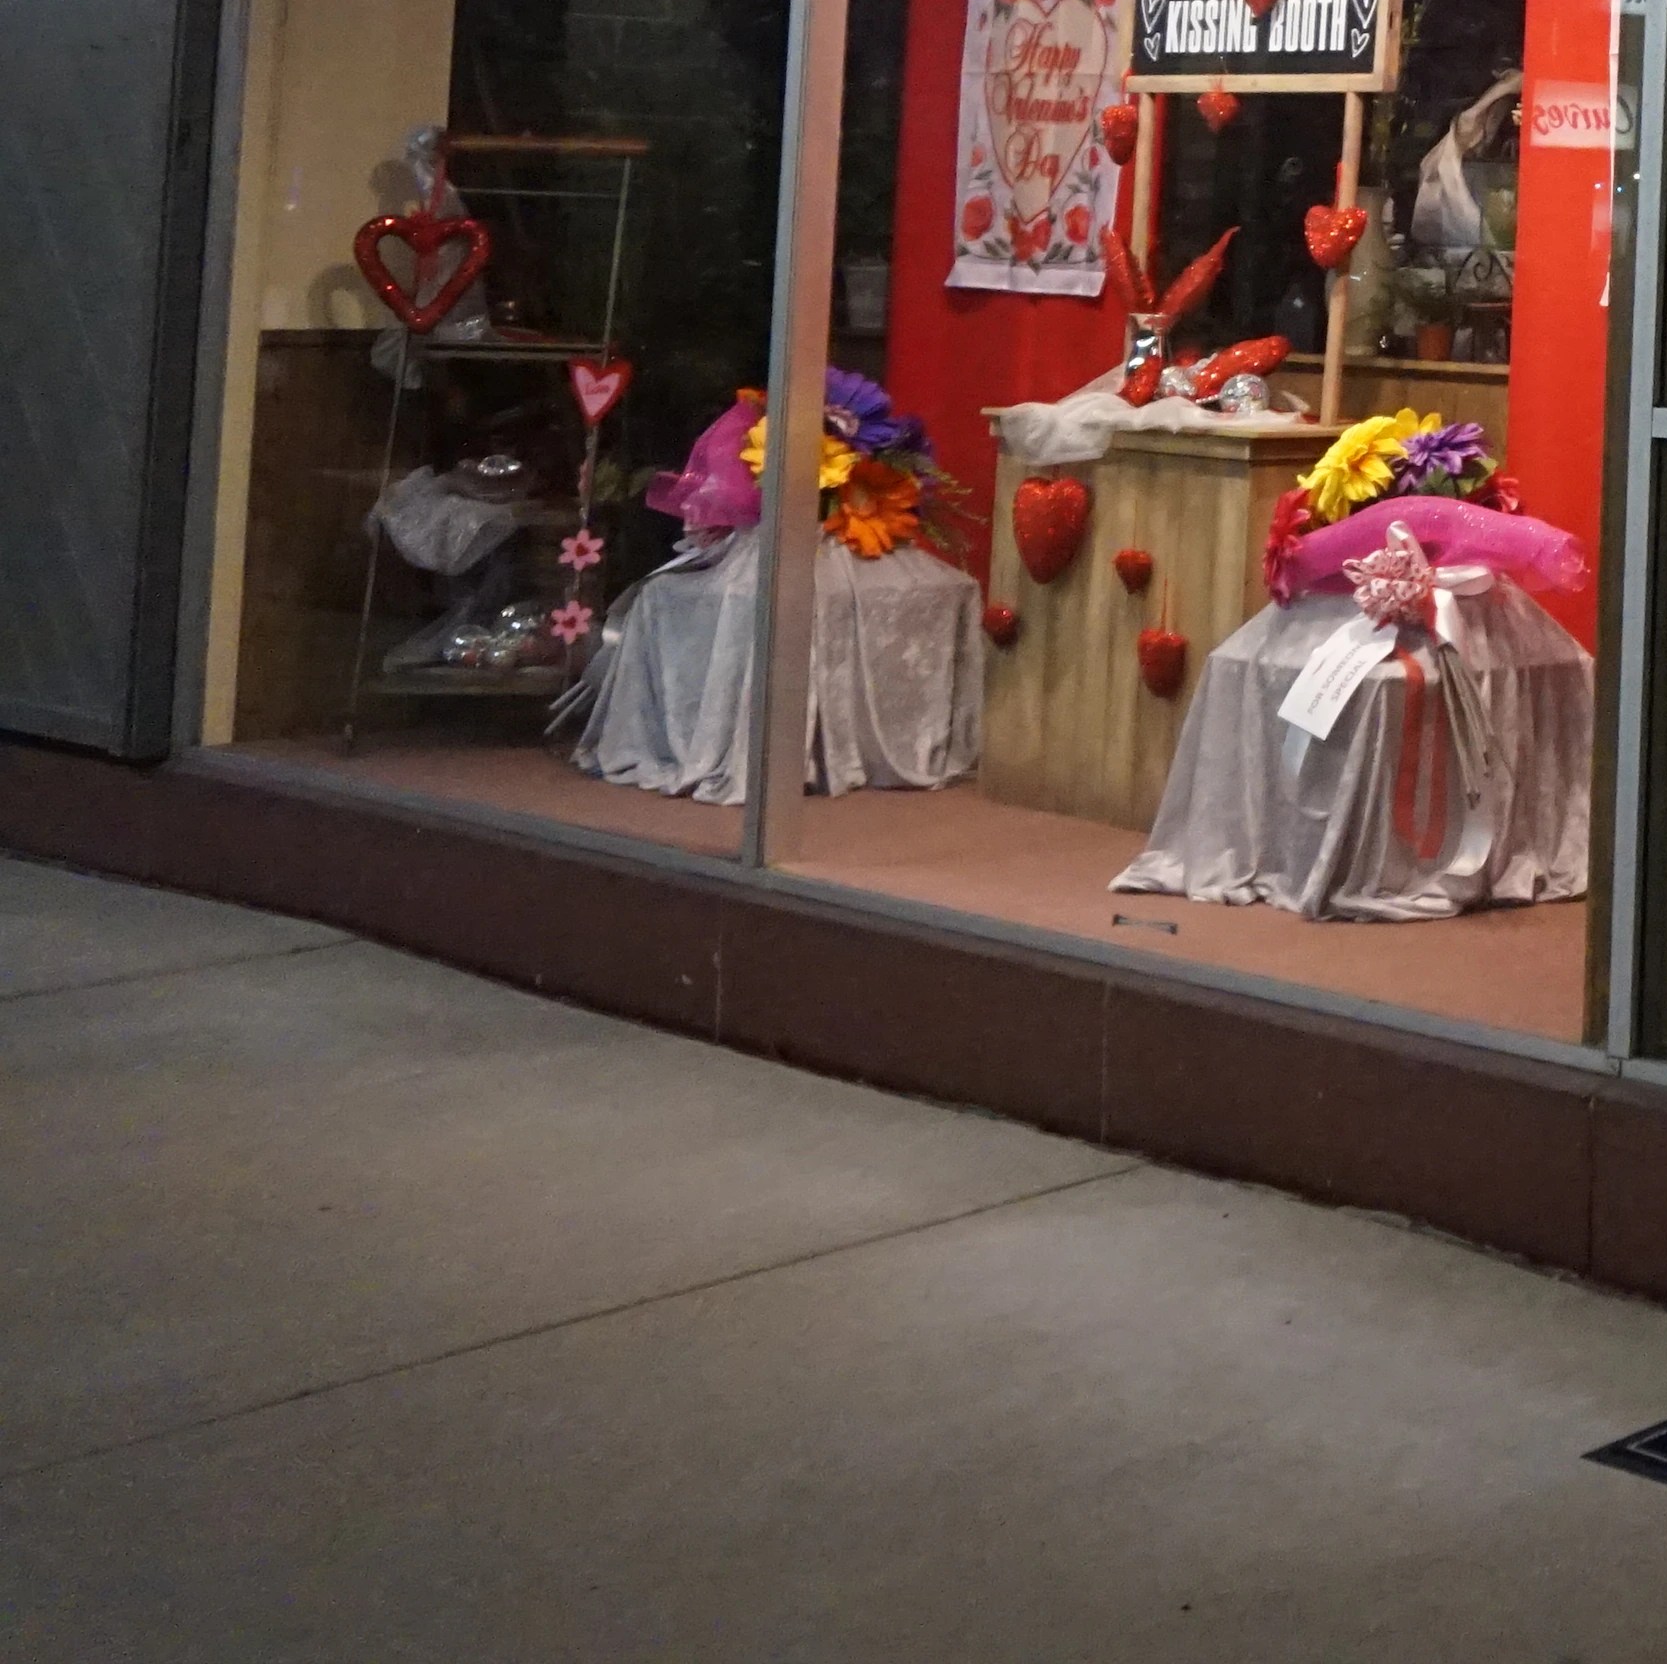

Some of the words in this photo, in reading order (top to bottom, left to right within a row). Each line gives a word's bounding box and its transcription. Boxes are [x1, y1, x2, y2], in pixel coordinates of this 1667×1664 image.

[1005, 17, 1082, 87] Happy
[1165, 0, 1257, 54] KISSING
[1005, 129, 1060, 193] Day
[1307, 692, 1325, 715] FOR
[1331, 659, 1367, 703] SPECIAL
